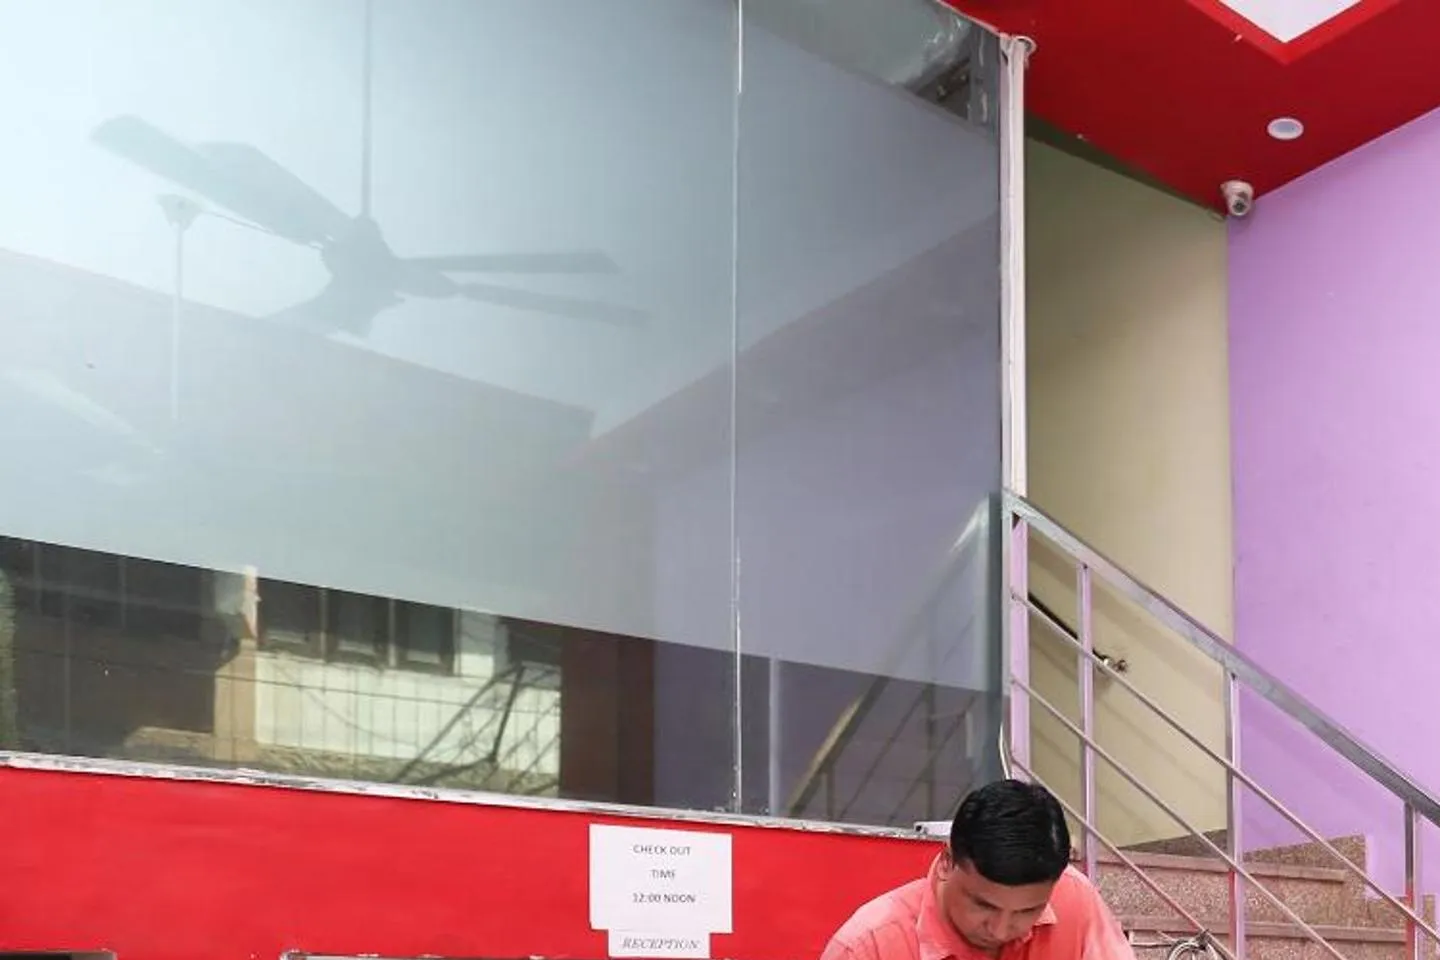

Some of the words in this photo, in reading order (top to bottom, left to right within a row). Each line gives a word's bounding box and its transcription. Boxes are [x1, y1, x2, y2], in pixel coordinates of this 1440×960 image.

[633, 845, 667, 855] CHECK
[669, 846, 692, 856] OUT
[651, 869, 676, 879] TIME
[632, 893, 661, 903] 12:00
[663, 894, 696, 904] NOON
[622, 937, 700, 950] RECEPTION
